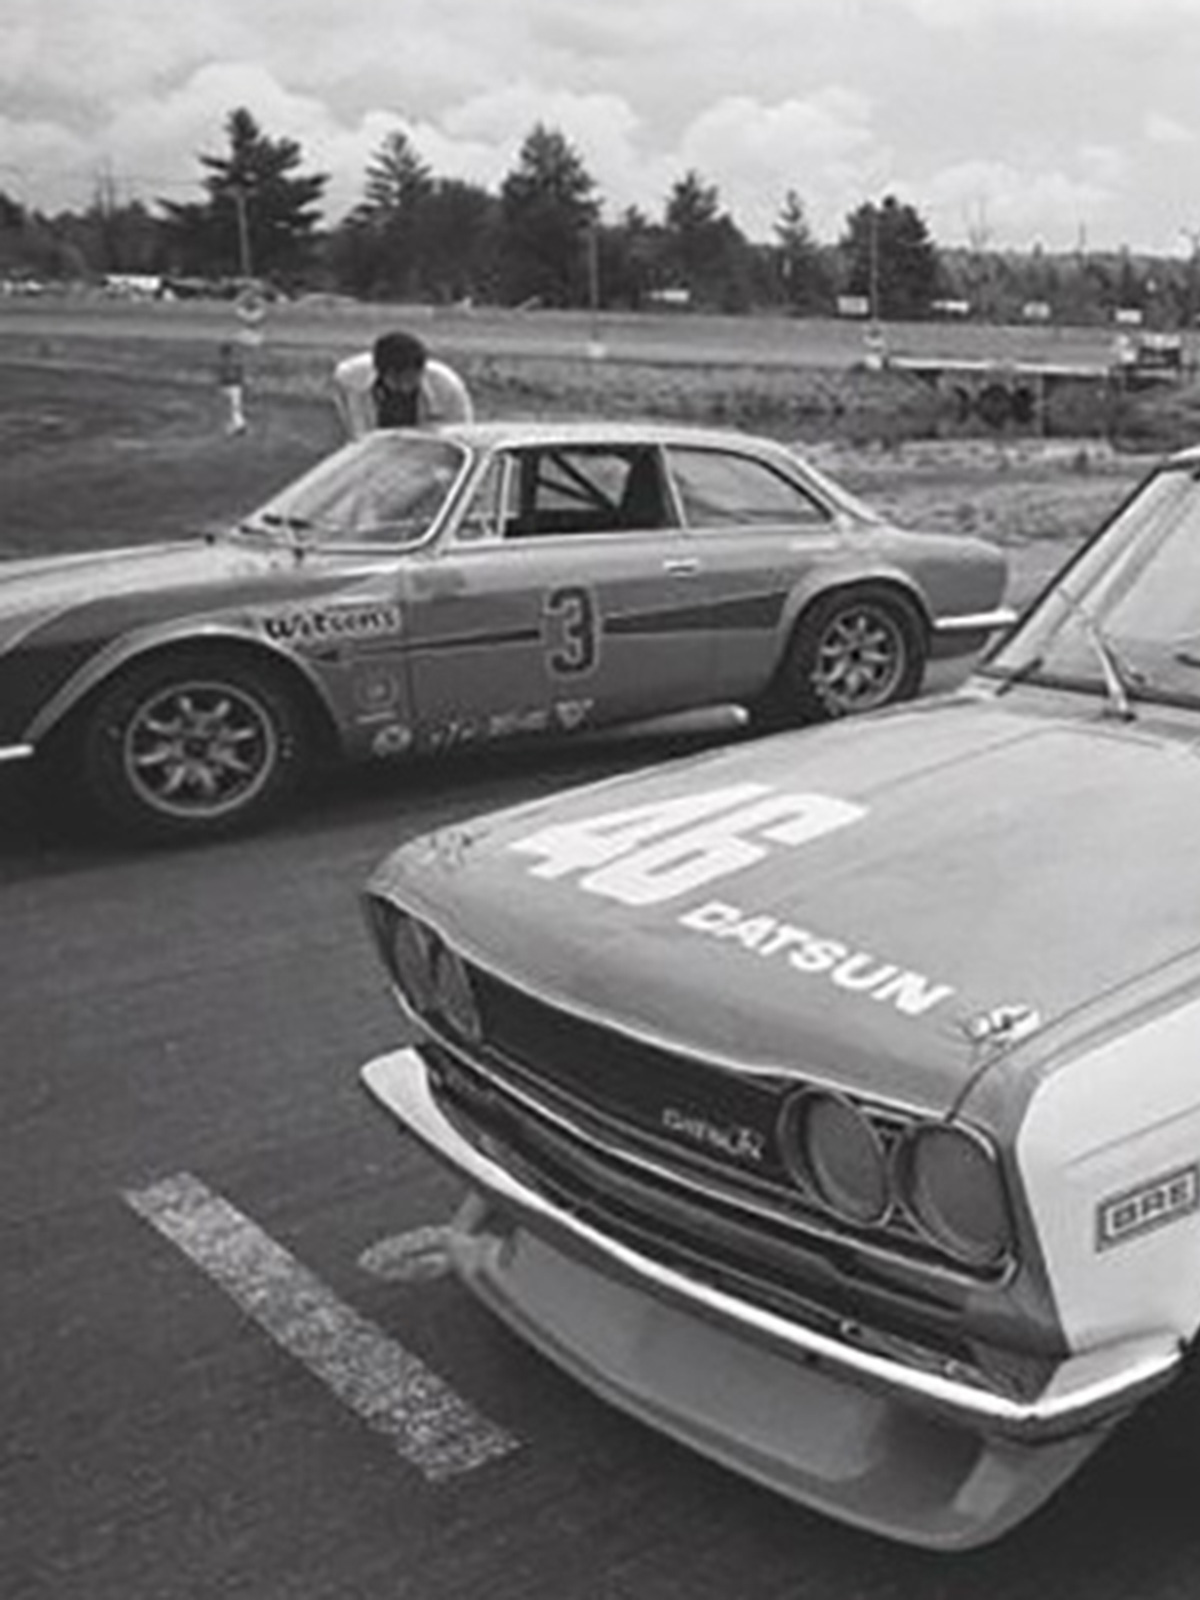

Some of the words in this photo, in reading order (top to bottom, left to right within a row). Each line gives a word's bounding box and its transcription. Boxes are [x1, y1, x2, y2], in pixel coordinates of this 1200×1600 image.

[548, 586, 596, 676] 3
[508, 783, 870, 907] 46
[677, 900, 954, 1014] DATSUN
[1108, 1175, 1192, 1232] BRE
